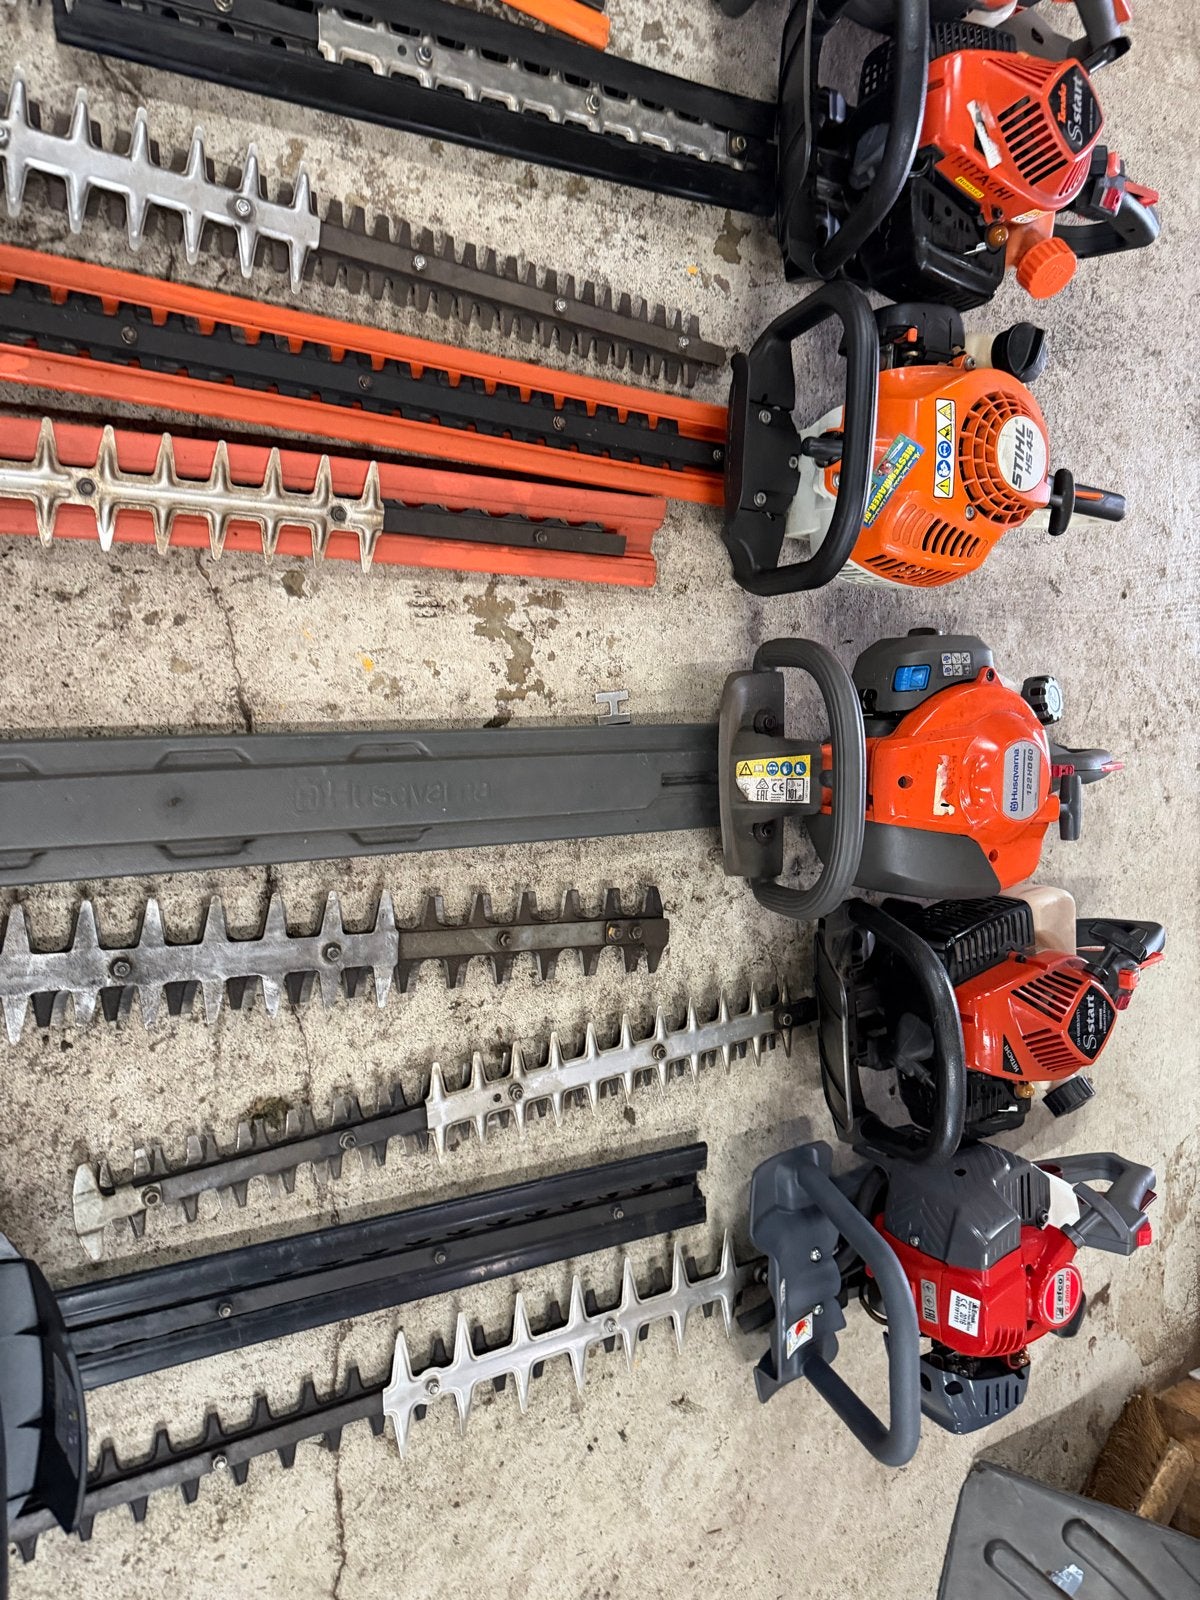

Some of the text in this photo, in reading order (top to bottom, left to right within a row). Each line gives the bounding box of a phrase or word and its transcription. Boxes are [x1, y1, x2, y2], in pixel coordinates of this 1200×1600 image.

[951, 155, 1015, 200] HITACHI
[1012, 423, 1025, 489] STIHL
[1025, 427, 1033, 475] HS 45
[1011, 749, 1020, 801] Husqvarna
[1004, 1044, 1020, 1073] HITACHI
